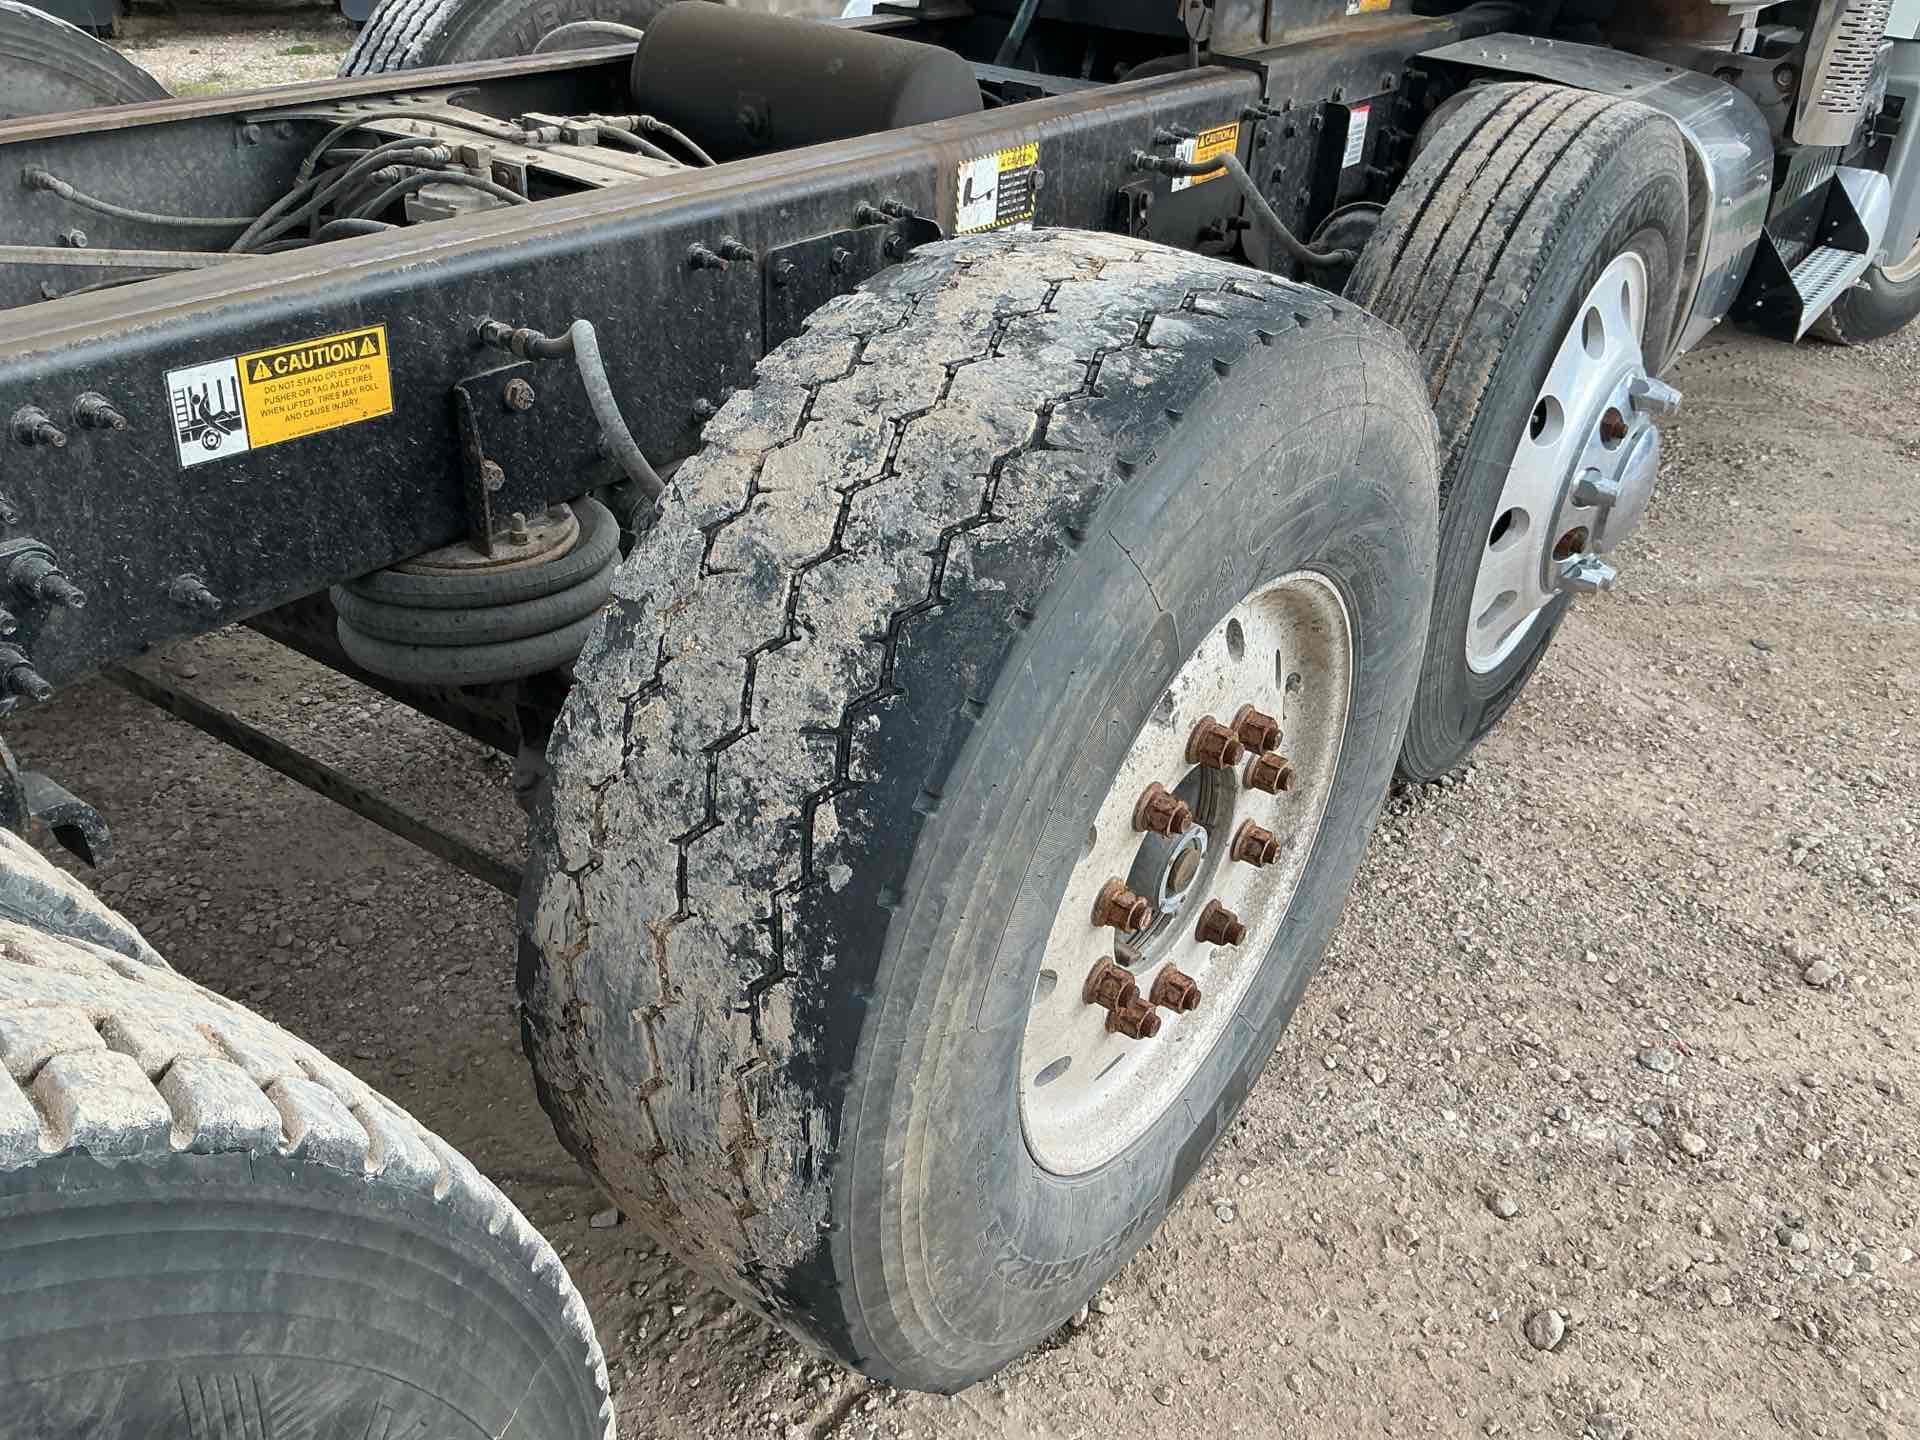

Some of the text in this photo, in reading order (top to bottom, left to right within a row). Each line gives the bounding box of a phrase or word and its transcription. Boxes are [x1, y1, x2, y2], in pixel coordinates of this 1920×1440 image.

[274, 340, 357, 374] CAUTION
[264, 386, 277, 394] DO
[278, 381, 295, 391] NOT
[297, 374, 324, 387] STAND
[337, 367, 356, 377] STEP
[359, 363, 371, 372] ON
[264, 373, 373, 406] PUSHER OR TAG AXLE TIRES
[260, 406, 285, 417] WHEN
[319, 393, 340, 404] TIRES
[342, 388, 358, 398] MAY
[359, 383, 379, 393] ROLL
[285, 412, 302, 422] AND
[303, 405, 331, 418] CAUSE
